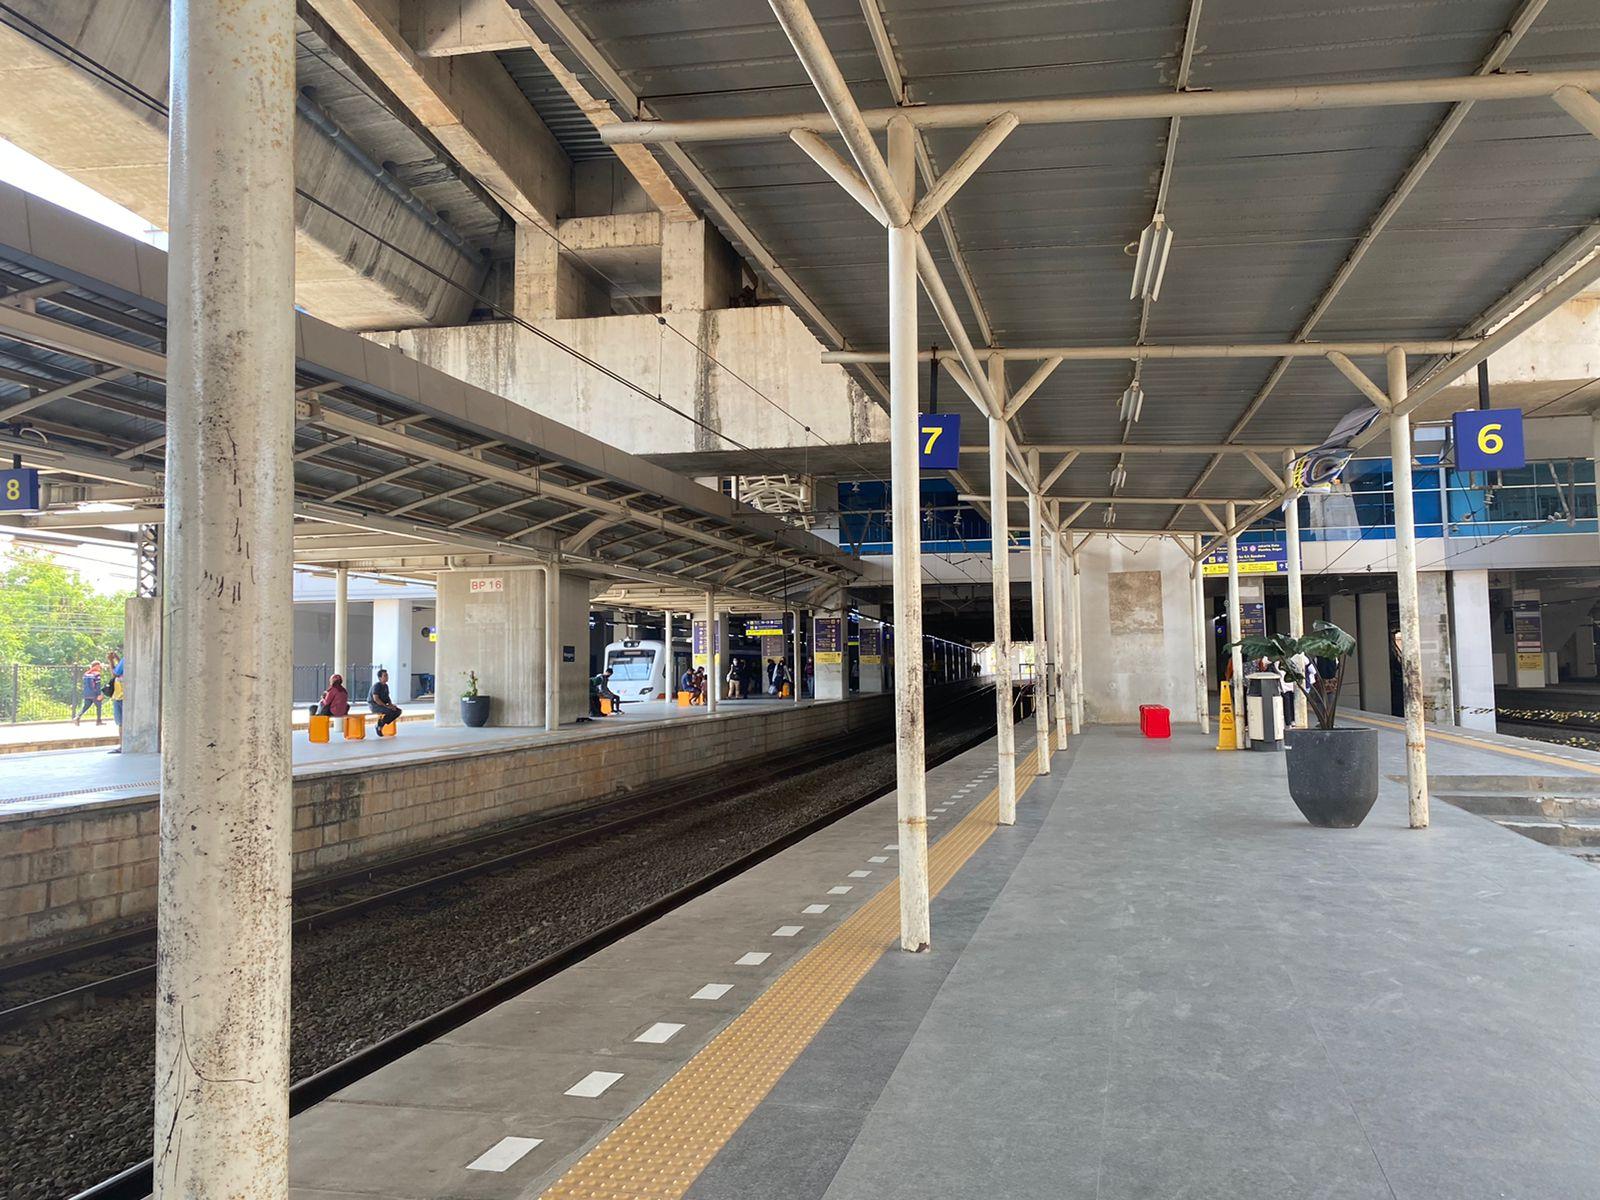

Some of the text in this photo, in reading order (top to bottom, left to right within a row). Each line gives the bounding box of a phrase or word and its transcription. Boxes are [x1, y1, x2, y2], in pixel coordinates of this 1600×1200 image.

[921, 426, 943, 455] 7
[1477, 423, 1504, 454] 6
[6, 478, 20, 501] 8
[471, 580, 502, 590] BP 16
